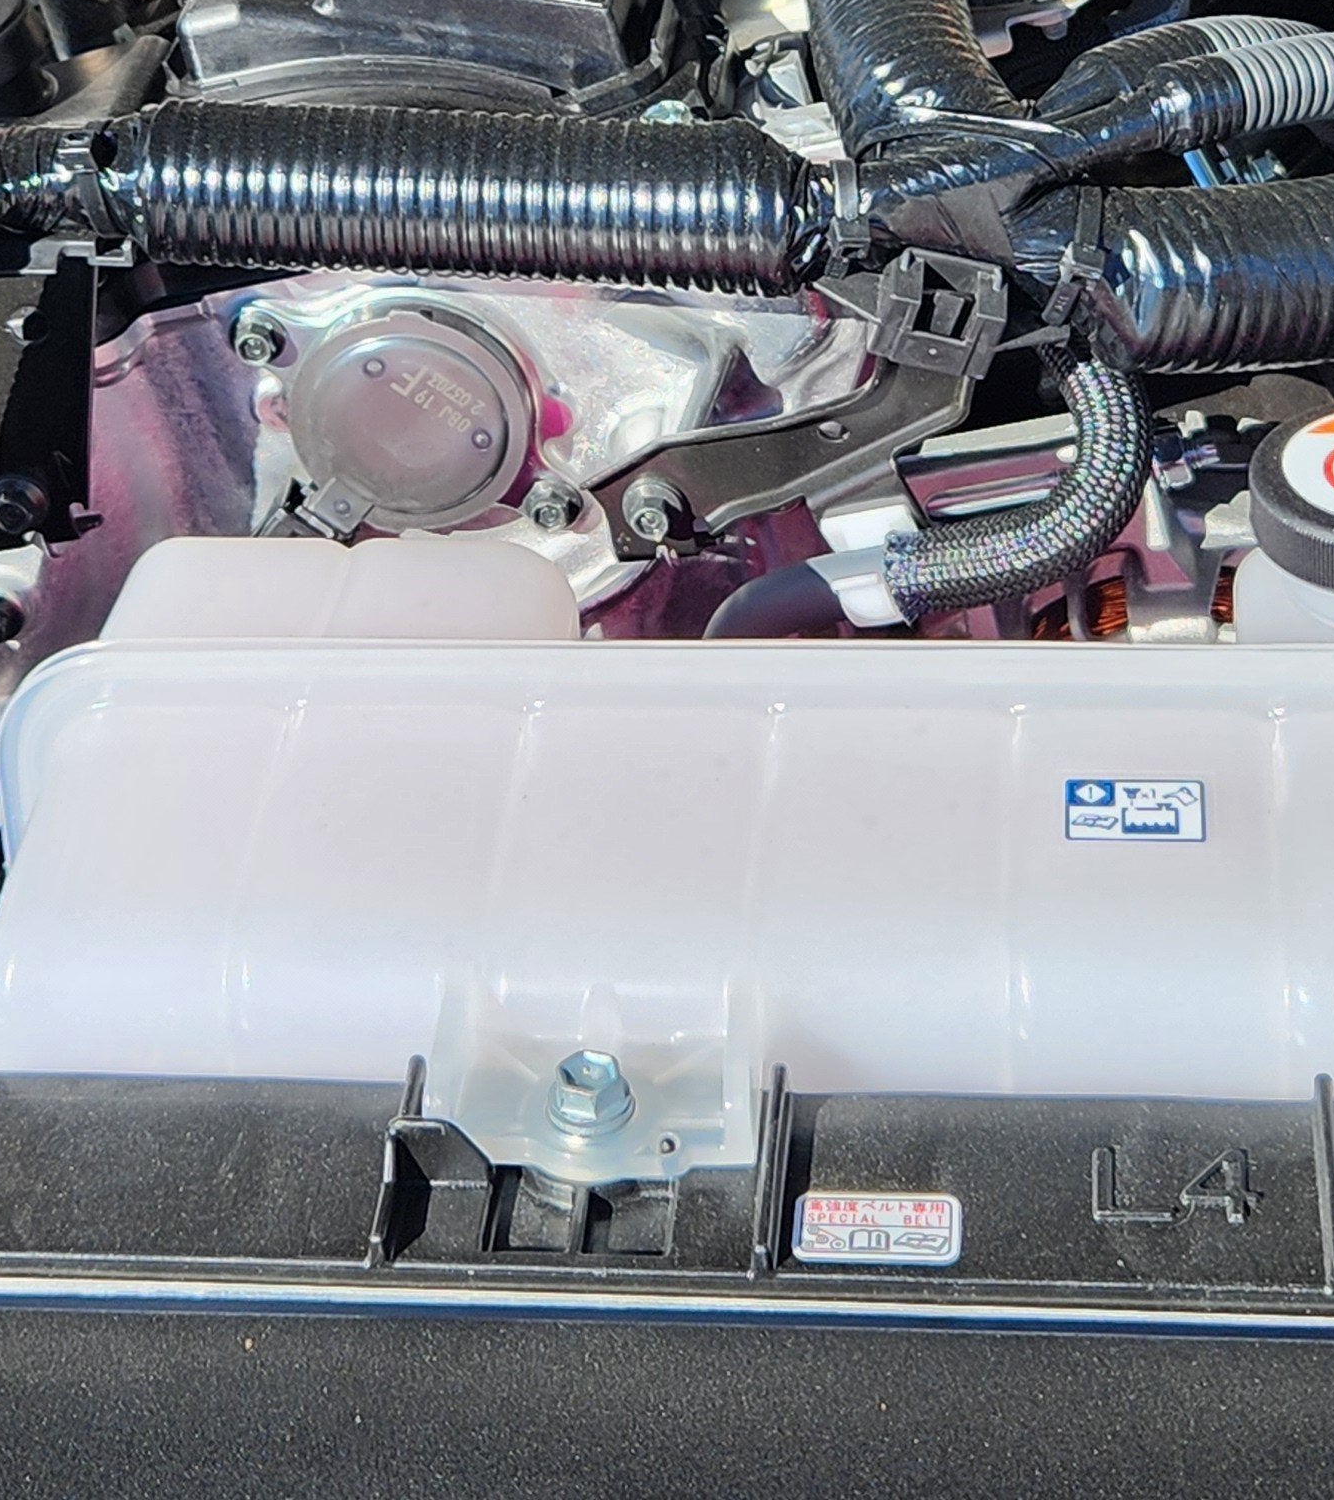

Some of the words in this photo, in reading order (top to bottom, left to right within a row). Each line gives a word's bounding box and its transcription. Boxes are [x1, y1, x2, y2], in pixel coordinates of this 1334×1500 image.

[1091, 1146, 1264, 1224] L4
[807, 1212, 879, 1224] SPECIAL
[903, 1214, 944, 1225] BELT
